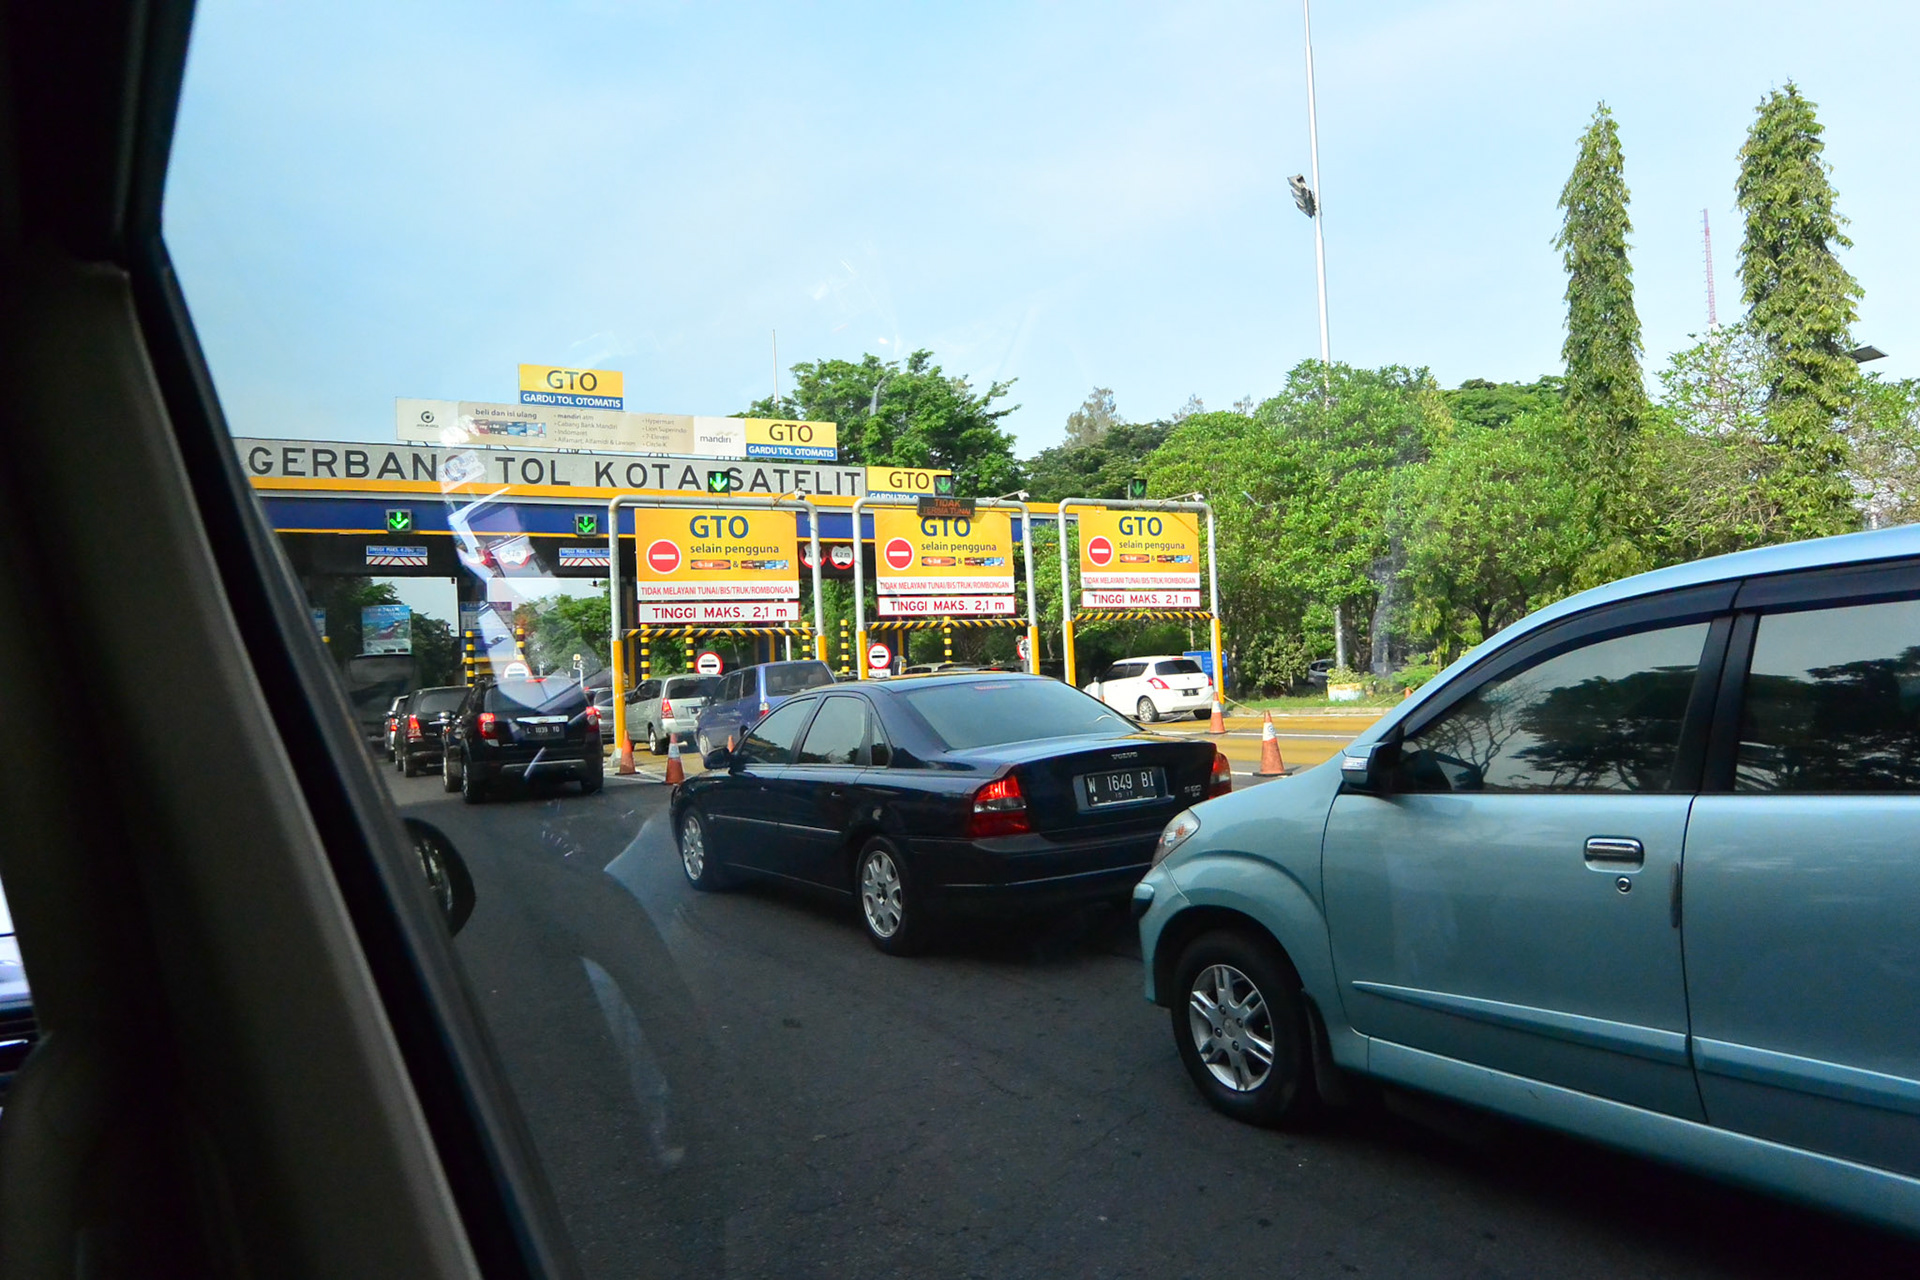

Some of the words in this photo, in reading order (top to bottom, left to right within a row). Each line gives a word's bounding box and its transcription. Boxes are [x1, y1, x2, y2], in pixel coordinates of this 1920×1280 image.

[546, 370, 598, 392] GTO
[523, 393, 556, 404] GARDU
[558, 396, 574, 405] TOL
[576, 397, 621, 408] OTOMATIS
[475, 408, 490, 416] beli
[491, 409, 505, 417] dan
[517, 411, 537, 419] ulang
[596, 422, 618, 430] Mandiri
[699, 435, 731, 443] mandiri
[769, 424, 813, 443] GTO
[748, 446, 777, 454] GARDU
[778, 447, 794, 455] TOL
[795, 448, 834, 457] OTOMATIS
[248, 446, 469, 482] GERBANG
[495, 456, 571, 486] TOL
[594, 461, 702, 491] KOTA
[727, 466, 861, 496] SATELIT
[889, 471, 930, 490] GTO
[934, 498, 961, 507] TIDAK
[689, 515, 749, 539] GTO
[920, 516, 971, 537] GTO
[1118, 516, 1163, 536] GTO
[690, 543, 723, 554] selain
[725, 544, 780, 556] pengguna
[921, 541, 949, 551] selain
[950, 543, 997, 553] pengguna
[1119, 540, 1143, 549] selain
[1144, 542, 1186, 552] pengguna
[732, 560, 739, 568] &
[641, 586, 663, 595] TIDAK
[663, 586, 697, 595] MELAYANI
[698, 586, 794, 595] TUNAI/BIS/TRUK/ROMBONGAN
[880, 581, 898, 590] TIDAK
[898, 582, 928, 590] MELAYANI
[890, 600, 928, 611] TINGGI
[934, 600, 968, 611] MAKS.
[975, 600, 989, 611] 2,1
[995, 602, 1005, 610] m
[1092, 594, 1125, 604] TINGGI
[1130, 594, 1161, 604] MAKS.
[1166, 594, 1179, 605] 2,1
[652, 607, 697, 619] TINGGI
[704, 606, 745, 618] MAKS.
[753, 606, 769, 619] 2,1
[776, 608, 787, 618] m
[1087, 777, 1096, 794] W
[1107, 773, 1133, 792] 1649
[1140, 771, 1154, 788] BI
